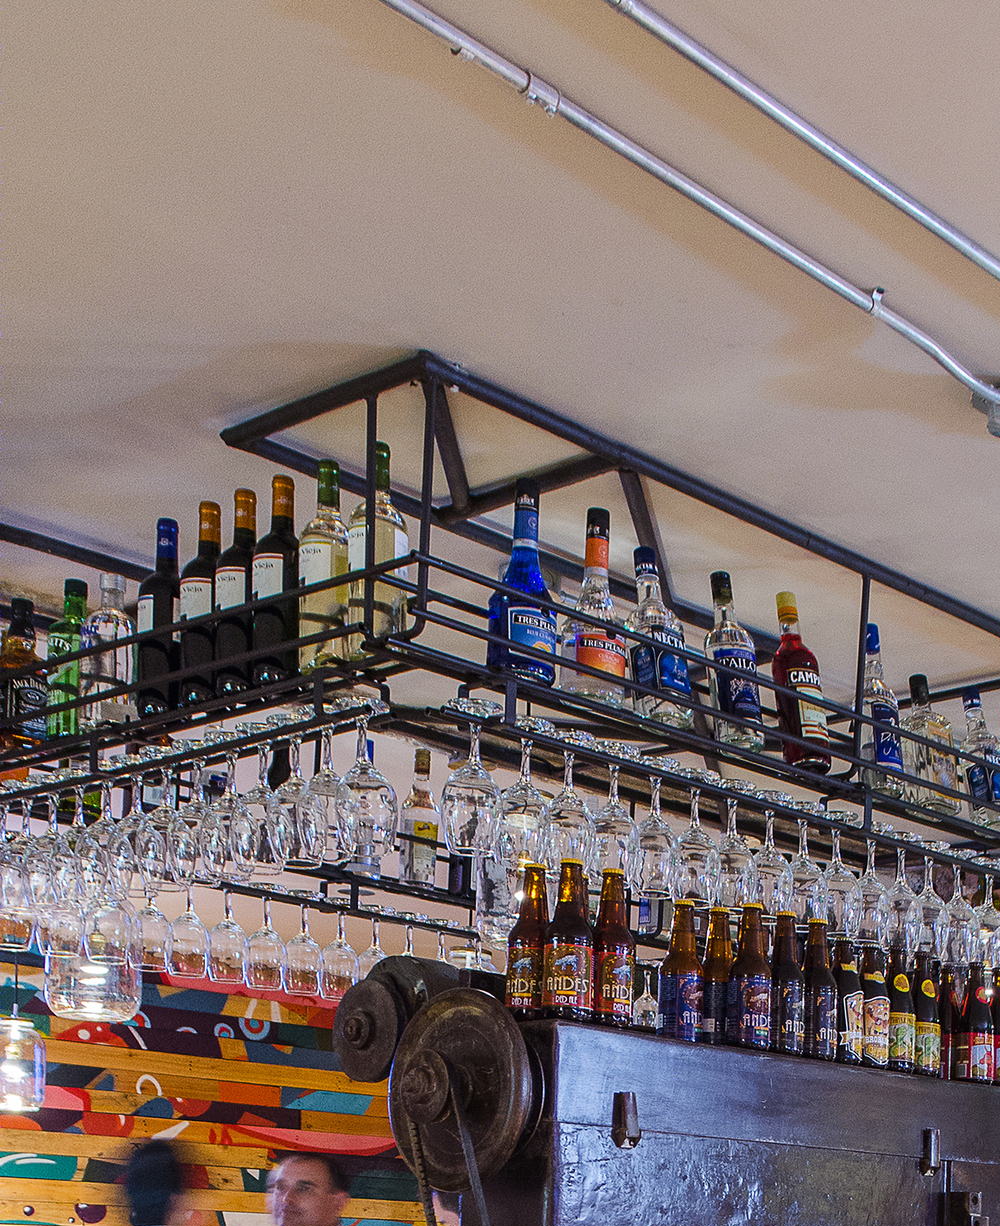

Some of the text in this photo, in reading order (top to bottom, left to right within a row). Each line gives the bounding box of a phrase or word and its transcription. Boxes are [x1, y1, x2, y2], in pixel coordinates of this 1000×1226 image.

[516, 615, 539, 627] TRES
[583, 639, 604, 649] TRES
[547, 976, 589, 993] ANDES
